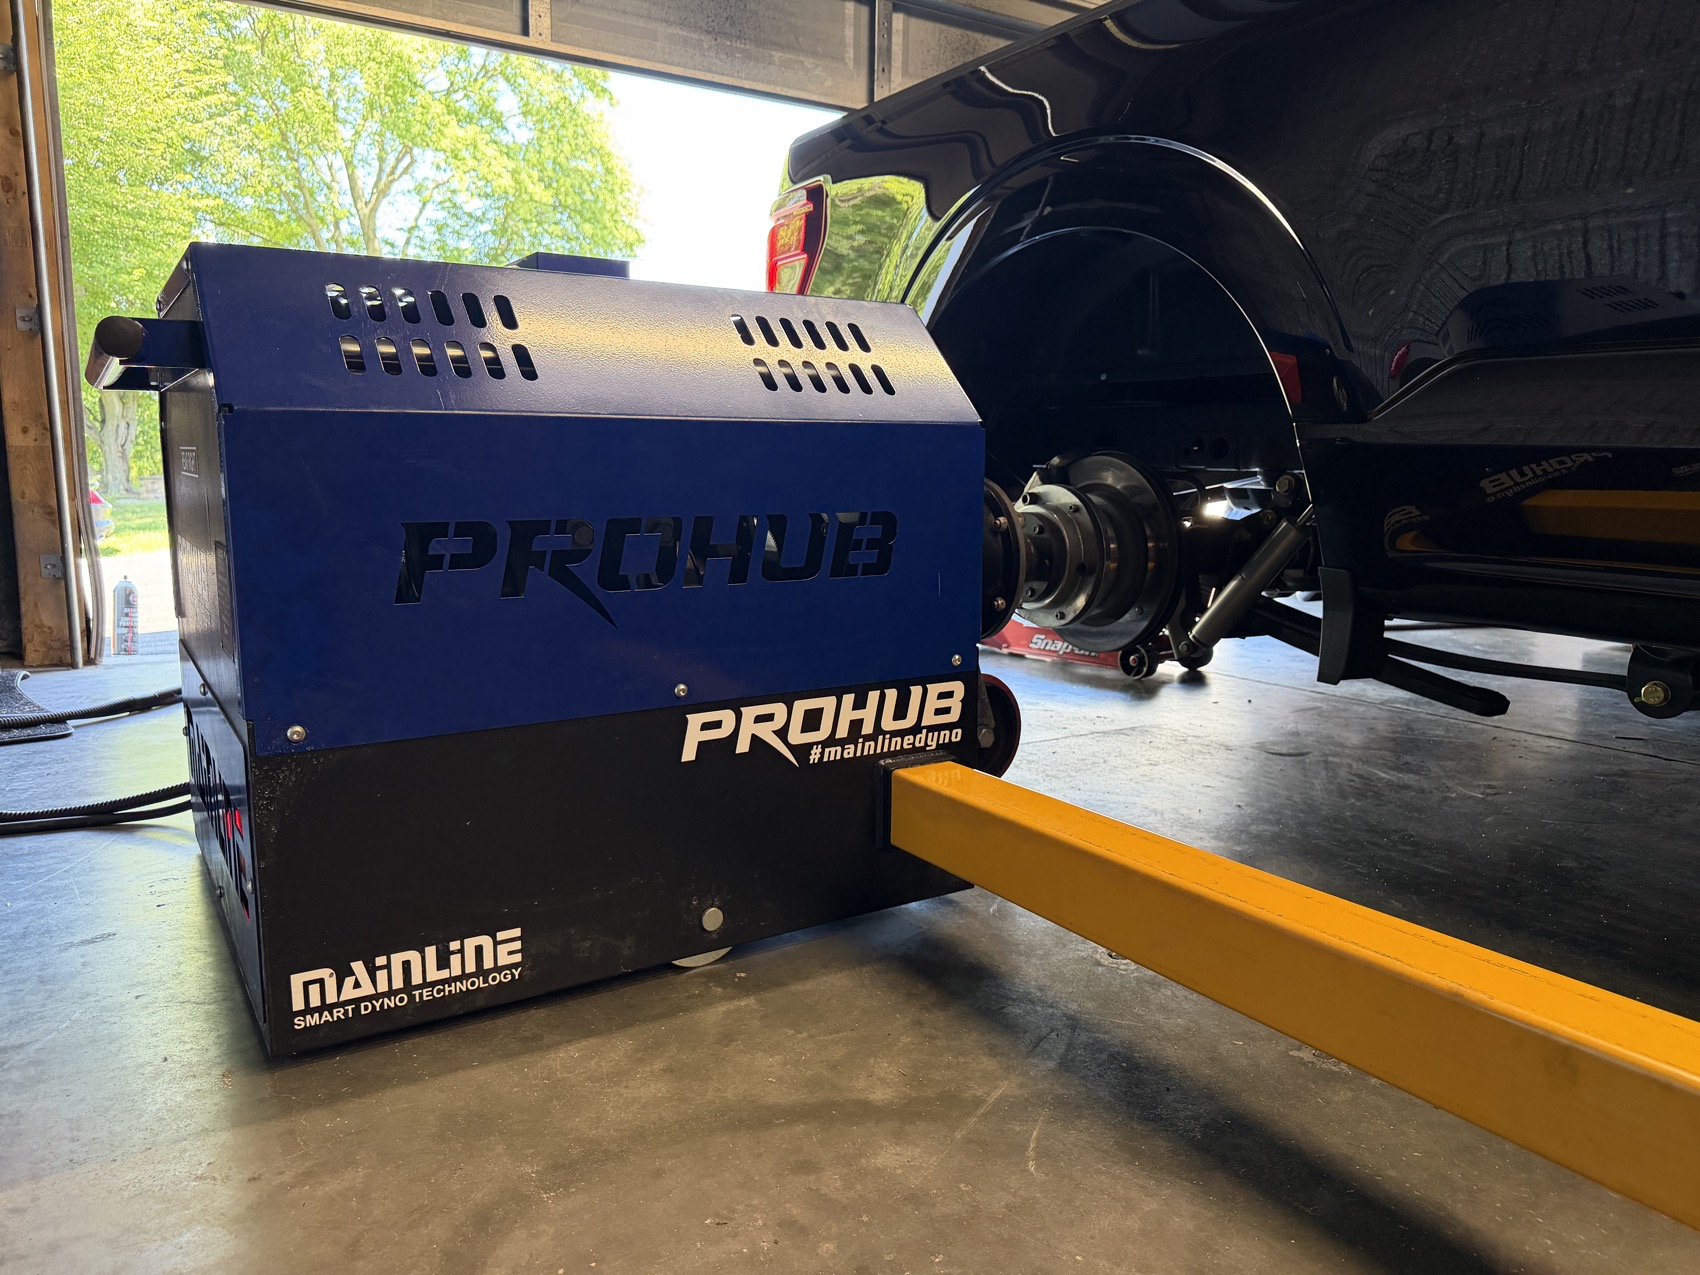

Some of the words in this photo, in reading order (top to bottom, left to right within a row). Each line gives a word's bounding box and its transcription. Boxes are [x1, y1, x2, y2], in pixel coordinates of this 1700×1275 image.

[394, 510, 899, 632] PROHUB
[680, 680, 966, 768] PROHUB
[808, 728, 963, 765] #mainlinedyno
[293, 1003, 356, 1030] SMART
[360, 993, 409, 1016] DYNO
[412, 966, 523, 1003] TECHNOLOGY
